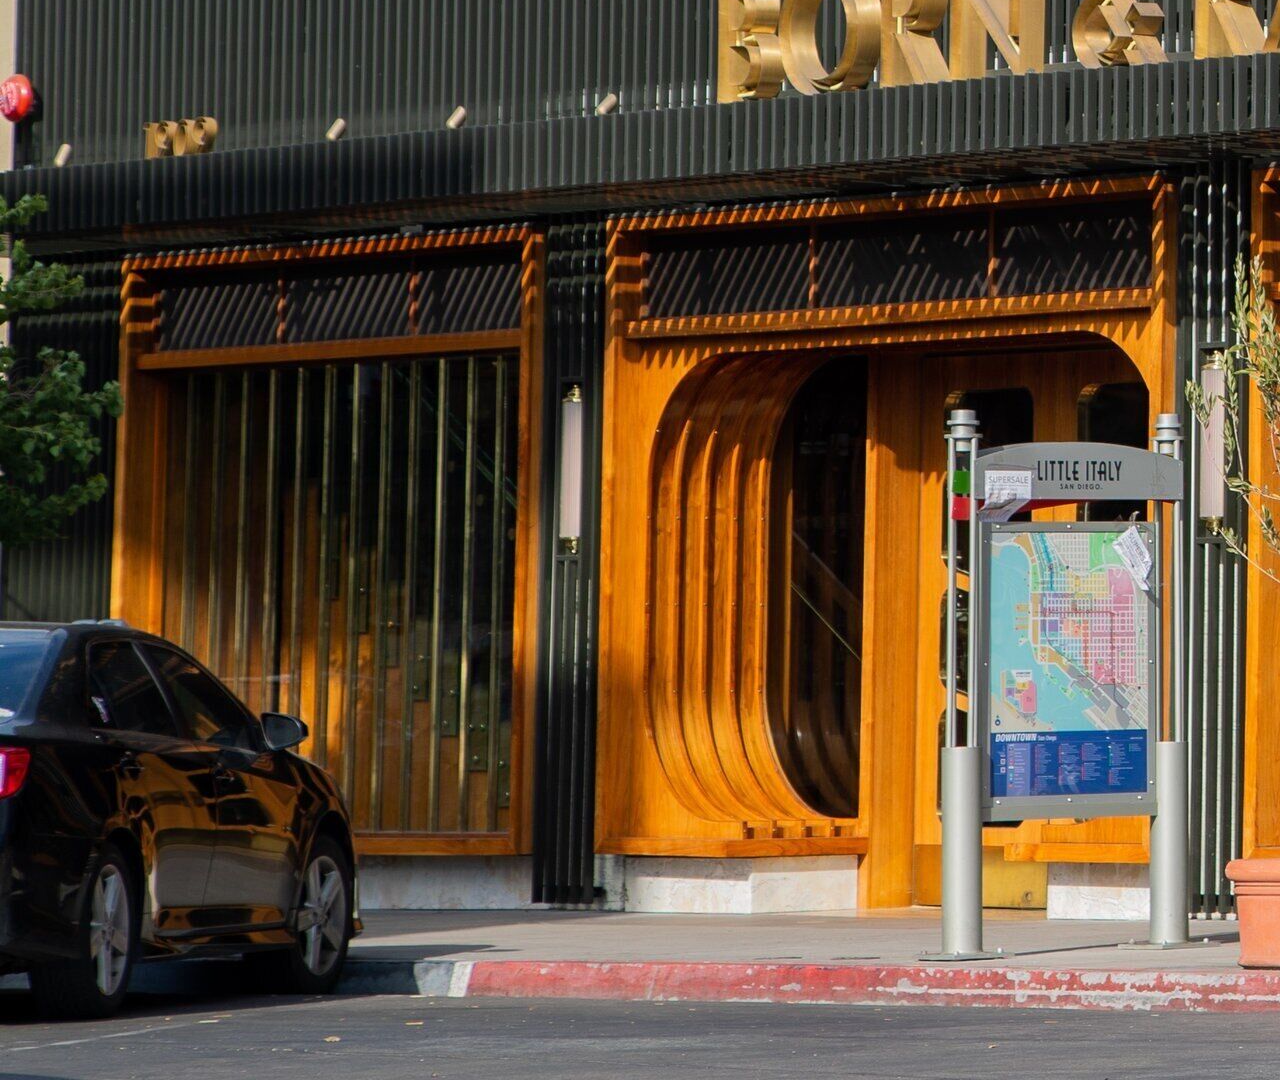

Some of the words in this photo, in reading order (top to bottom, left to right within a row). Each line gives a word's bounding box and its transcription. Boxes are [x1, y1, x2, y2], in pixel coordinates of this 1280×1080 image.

[1037, 460, 1079, 481] LITTLE
[1086, 460, 1122, 481] ITALY
[988, 475, 1029, 484] SUPERSALE
[995, 733, 1037, 743] DOWNTOWN
